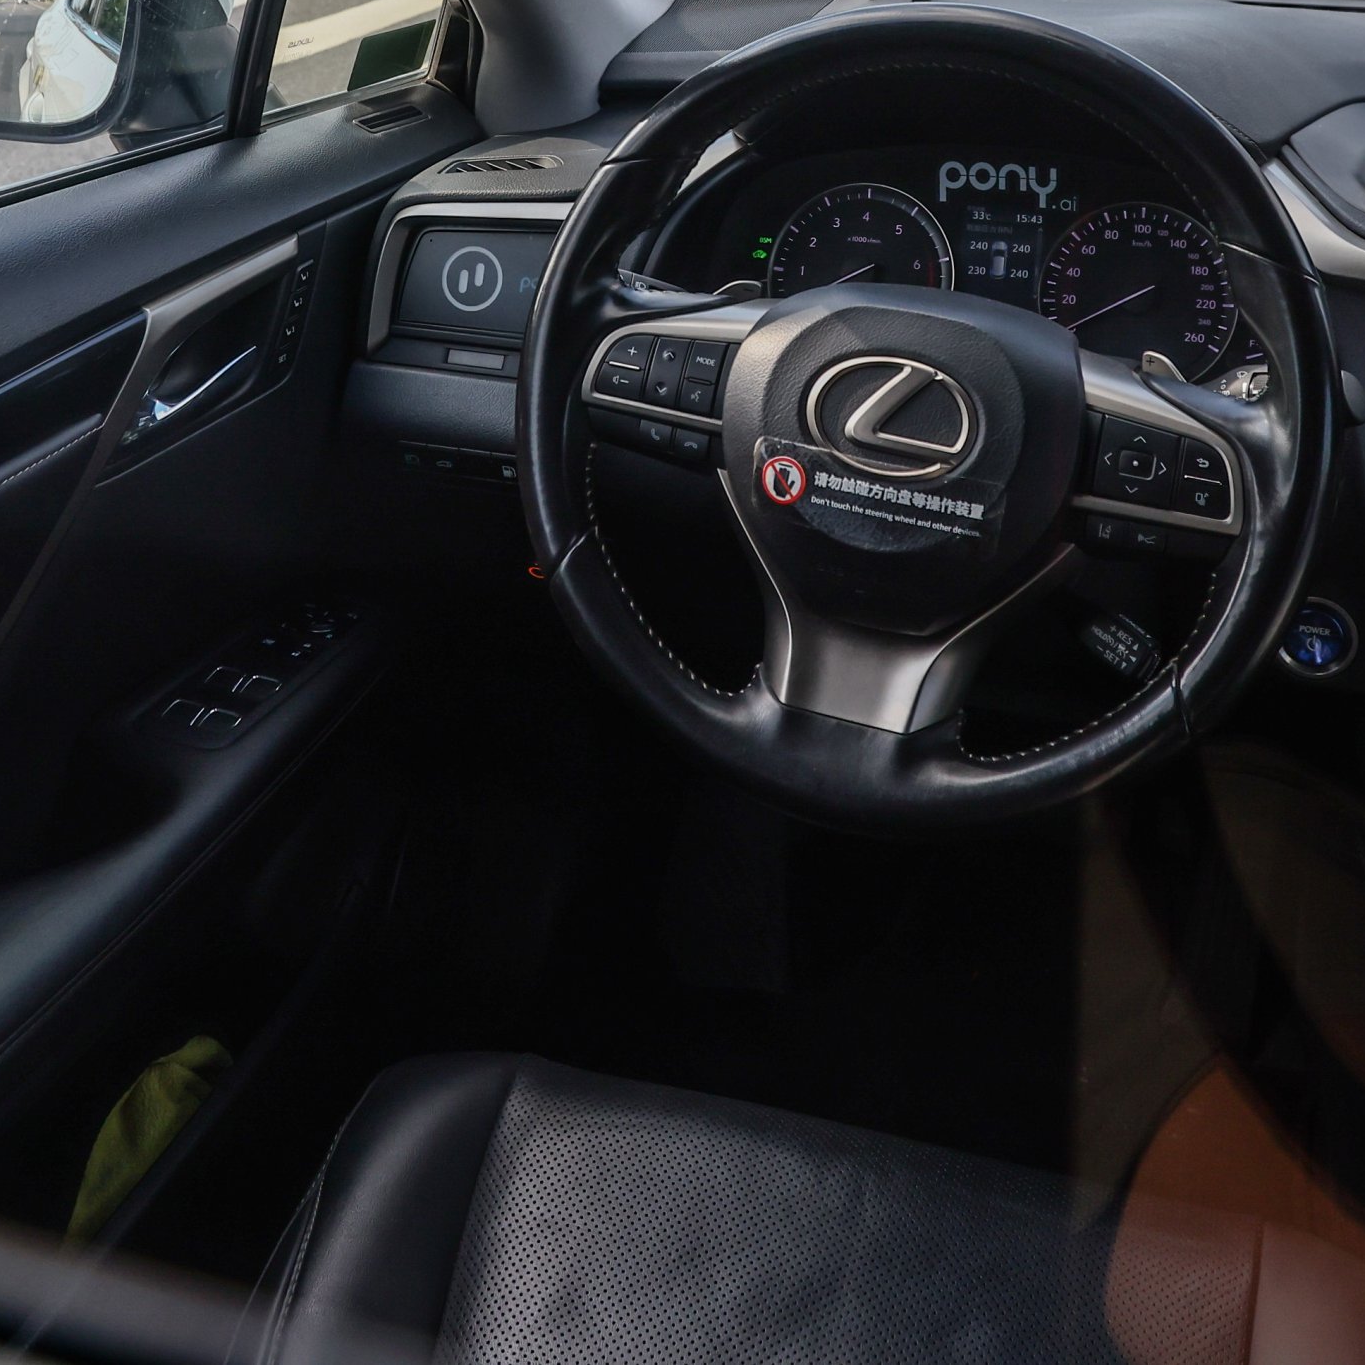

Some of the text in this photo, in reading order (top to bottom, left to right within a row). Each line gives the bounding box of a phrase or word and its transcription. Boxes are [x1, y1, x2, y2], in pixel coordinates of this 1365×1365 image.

[862, 212, 870, 222] 4
[1016, 214, 1043, 224] 15:43
[832, 218, 841, 228] 3
[895, 225, 903, 234] 5
[1134, 224, 1152, 234] 100
[1105, 230, 1119, 240] 80
[809, 237, 817, 247] 2
[970, 241, 1031, 253] 240 240
[1170, 239, 1187, 249] 140
[1081, 245, 1096, 255] 60
[913, 260, 921, 270] 6
[800, 266, 805, 276] 1
[968, 266, 1029, 278] 230 240
[1066, 267, 1081, 277] 40
[1190, 266, 1209, 276] 180
[1062, 294, 1077, 305] 20
[1196, 300, 1217, 310] 220
[1184, 332, 1205, 343] 260
[696, 356, 715, 367] MODE
[814, 472, 985, 521] 请勿触碰方向盘等操作装置
[811, 496, 830, 507] Don't
[831, 500, 851, 511] touch
[852, 505, 864, 514] the
[864, 508, 893, 522] steering
[895, 515, 916, 525] wheel
[917, 520, 931, 528] and
[932, 522, 952, 532] other
[1299, 625, 1330, 636] POWER
[1117, 630, 1133, 645] RES
[1104, 649, 1120, 665] SET
